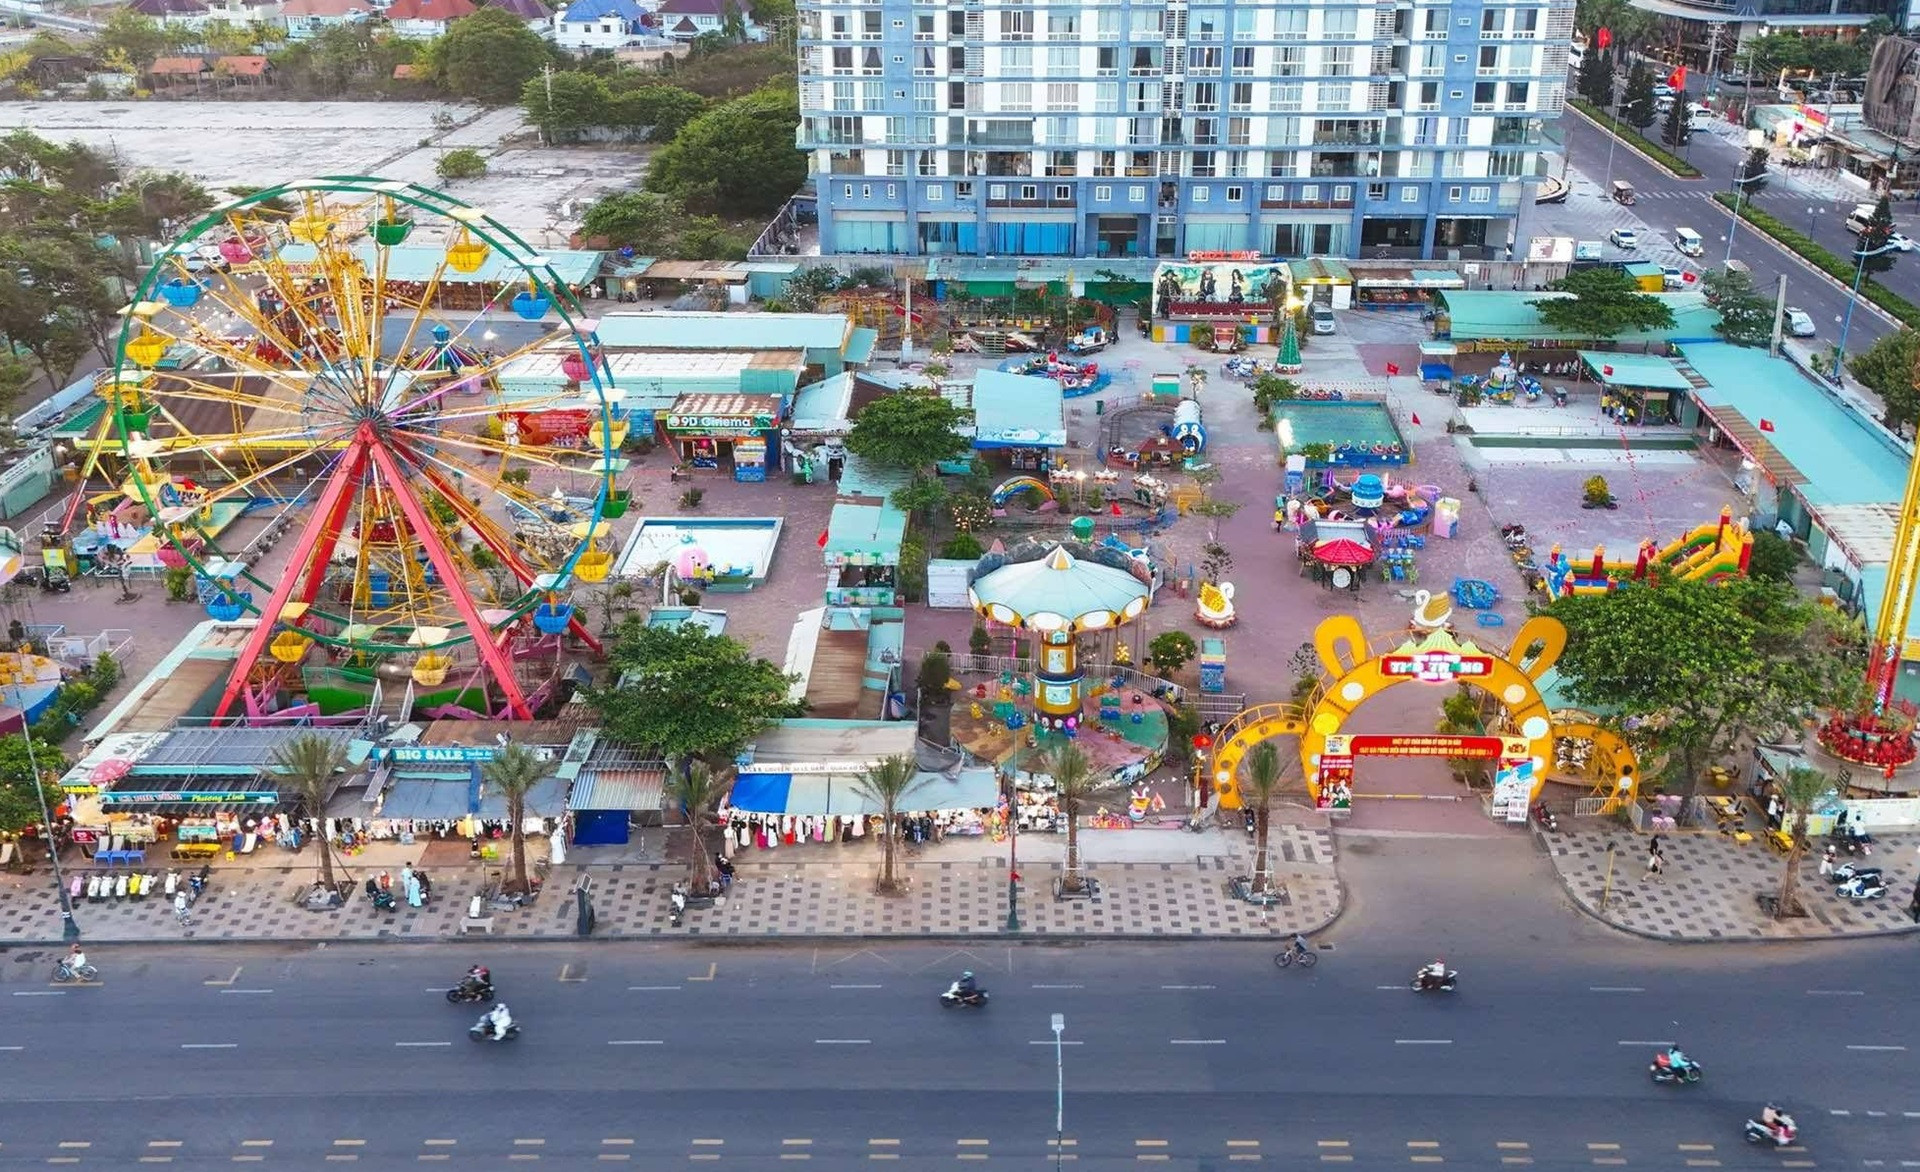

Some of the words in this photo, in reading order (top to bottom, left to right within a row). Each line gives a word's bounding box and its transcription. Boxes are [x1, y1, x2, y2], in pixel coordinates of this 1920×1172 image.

[681, 416, 698, 427] 9D
[701, 416, 751, 427] Cinema
[395, 749, 422, 760] BIG
[426, 749, 464, 760] SALE
